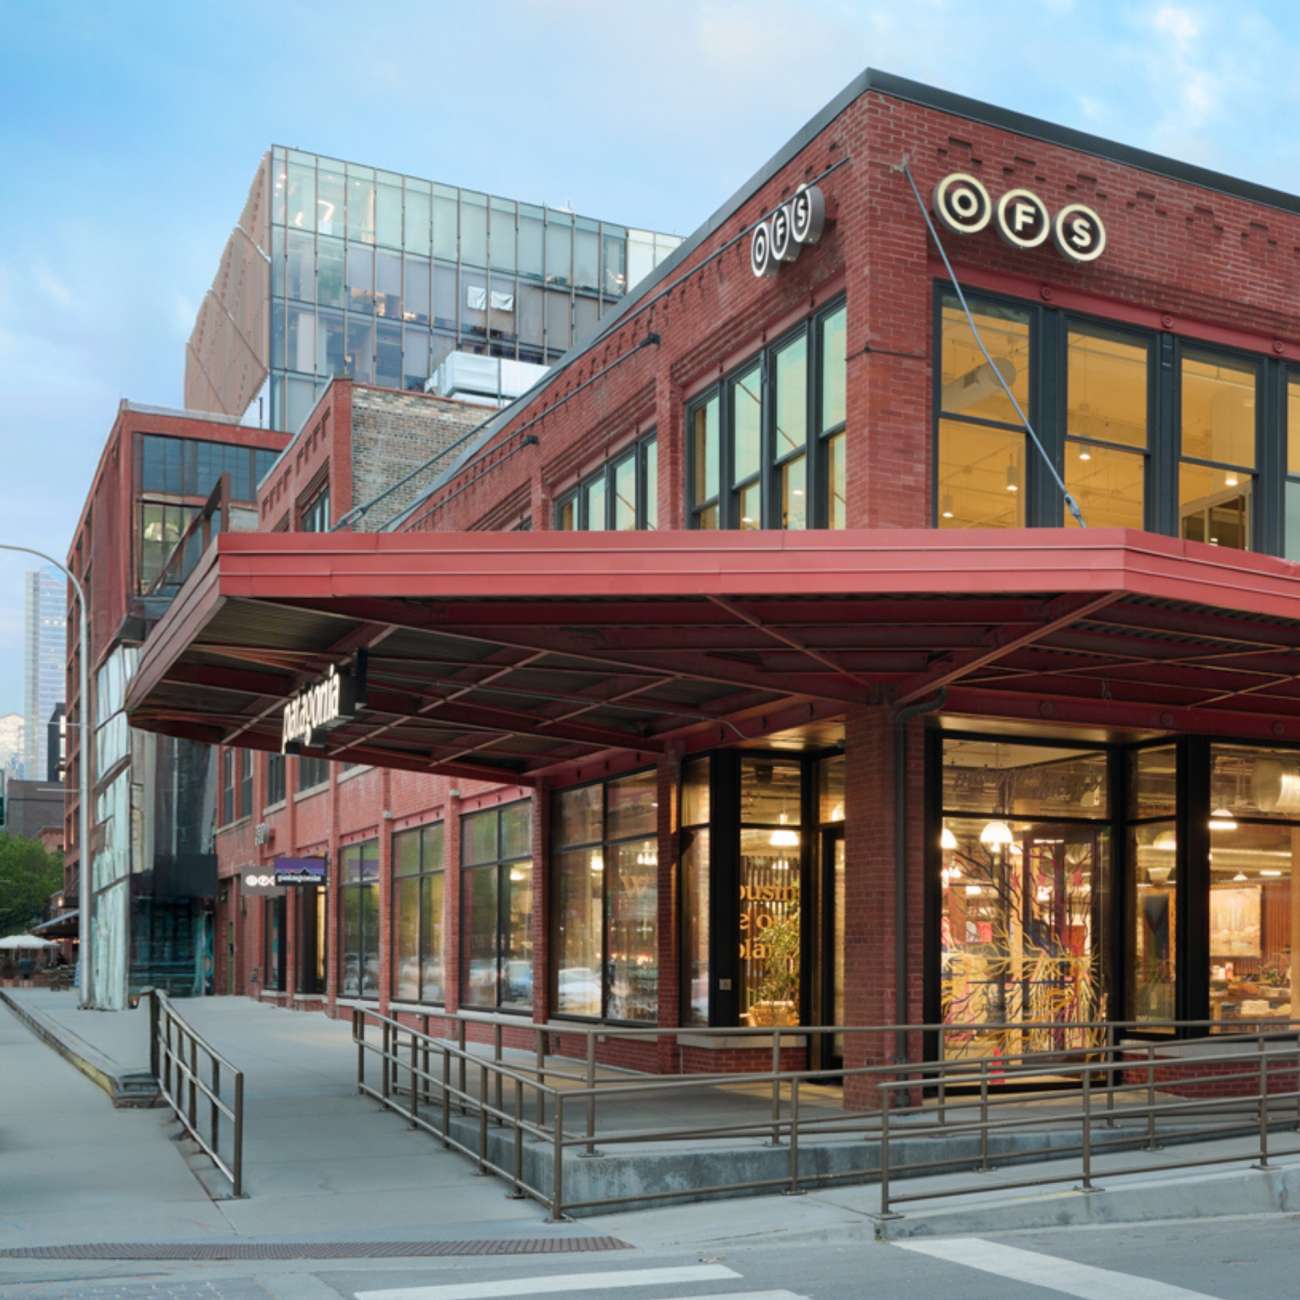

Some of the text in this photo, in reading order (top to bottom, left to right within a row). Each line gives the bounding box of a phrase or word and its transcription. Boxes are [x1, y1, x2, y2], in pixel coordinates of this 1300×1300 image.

[754, 189, 809, 271] OFS
[941, 178, 1101, 256] OFS
[281, 663, 340, 755] patagonia
